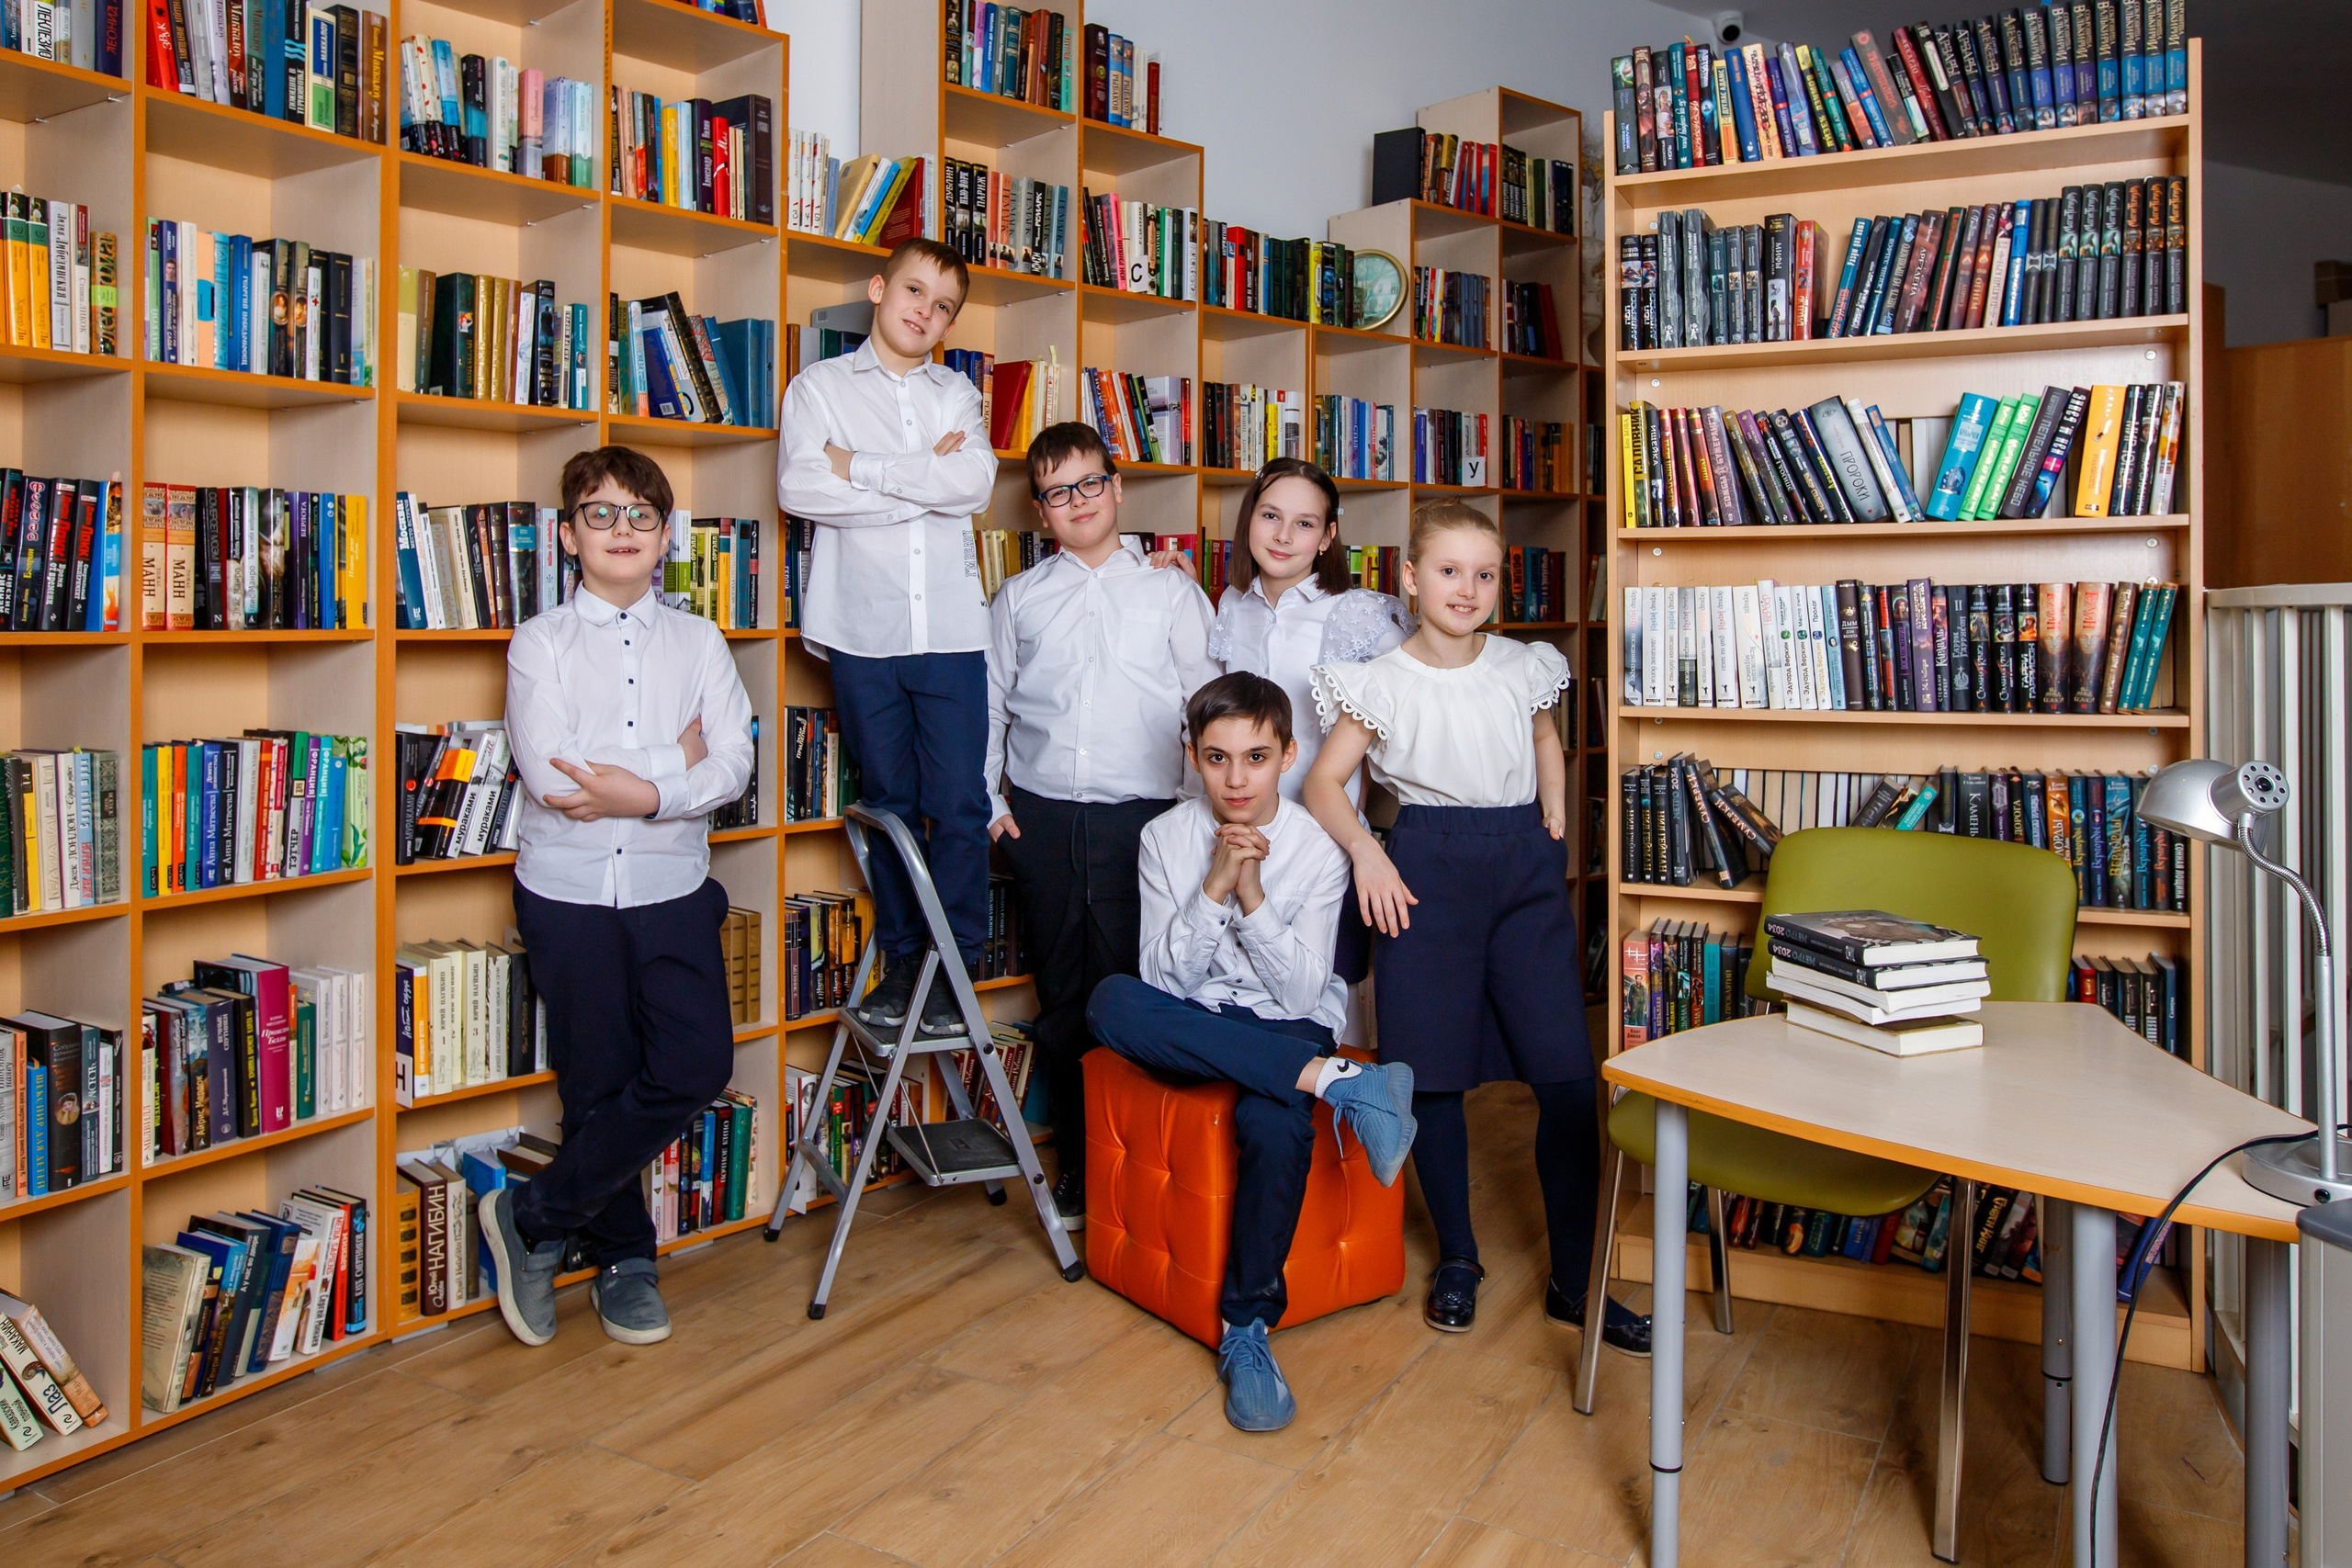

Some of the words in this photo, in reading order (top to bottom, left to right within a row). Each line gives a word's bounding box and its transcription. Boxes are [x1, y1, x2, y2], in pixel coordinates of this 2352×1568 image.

[37, 4, 53, 60] ЛЕКЛЕЗИО
[230, 2, 243, 59] Маккалоу
[2027, 12, 2042, 65] ВАЛЬКИРИИ
[2052, 7, 2066, 61] ВАЛЬКИРИИ
[2075, 5, 2088, 58] ВАЛЬКИРИИ
[1901, 39, 1918, 75] АККАРДО
[1938, 30, 1958, 75] АРВАРЫ
[296, 68, 305, 115] ТЕРНОВНИКЕ
[369, 49, 384, 100] Маккалоу
[1111, 73, 1119, 111] РЫБАКОВ
[1717, 69, 1726, 92] АДАМС
[1122, 79, 1131, 116] РЫБАКОВ
[1719, 92, 1730, 115] ДУГЛАС
[945, 166, 955, 203] ДУБЛИН
[976, 176, 986, 208] ПАРИЖ
[1034, 192, 1043, 227] РЕМАРК
[55, 237, 69, 299] Либединская
[1774, 242, 1782, 270] МИФЫ
[241, 275, 249, 308] ГЕОРГИЙ
[1887, 289, 1901, 310] МЕСТЬ
[1894, 243, 1910, 276] ПРОШЛОГО
[79, 302, 87, 333] ЛИКОК
[1630, 288, 1638, 342] АНДЕРСОН
[1648, 289, 1657, 342] АНДЕРСОН
[239, 310, 249, 366] ПОБЕДОНОСЕЦ
[1650, 424, 1660, 467] ИЩЕЙКА
[1707, 412, 1724, 465] БУМЕРАНГИ
[2021, 419, 2051, 478] ПЕПЕЛЬНОЕ
[1720, 475, 1732, 508] БОМБЫ
[1839, 450, 1871, 502] ПРОРОКИ
[2009, 479, 2030, 507] НЕБО
[51, 517, 72, 558] ЛОКК
[300, 501, 308, 537] БЕРЛОГА
[396, 499, 410, 550] Москва:
[79, 525, 93, 557] ЛОКК
[689, 534, 697, 561] ОРУЭЛЛ
[55, 562, 65, 588] Время
[143, 557, 155, 597] МАНН
[173, 559, 185, 599] МАНН
[232, 568, 243, 594] Манро
[247, 565, 256, 592] Манро
[1782, 642, 1792, 666] Веркин
[1799, 641, 1808, 666] Веркин
[1952, 632, 1961, 659] ГАРРИ
[1957, 615, 1967, 657] ГАРРИСОН
[1784, 667, 1794, 695] Эдуард
[1801, 667, 1810, 695] Эдуард
[2028, 643, 2037, 699] ГАРРИСОН
[1669, 767, 1679, 790] 2034
[223, 794, 233, 838] Матвеева
[405, 794, 415, 840] МУРАКАМИ
[476, 790, 497, 842] мураками
[1672, 790, 1680, 819] МЕТРО
[1687, 773, 1711, 824] СУМЕРКИ
[1968, 792, 1982, 837] КАМЕНЬ
[2012, 799, 2023, 835] ДОРОГА
[208, 795, 218, 840] Матвеева
[456, 793, 478, 844] мураками
[1642, 808, 1652, 830] НИЛ
[1657, 810, 1667, 831] НИЛ
[1713, 798, 1757, 840] СУМЕРКИ
[67, 813, 77, 861] ЛОНДОН
[208, 840, 217, 866] Анна
[222, 839, 232, 864] Анна
[288, 829, 299, 870] ТЭТЧЕР
[1643, 831, 1654, 872] ГЕЙМАН
[1657, 832, 1668, 874] ГЕЙМАН
[2174, 842, 2184, 869] СОННАЯ
[69, 864, 79, 891] Джек
[2174, 869, 2185, 900] ЛОЩИНА
[471, 963, 480, 998] НАГИБИН
[471, 999, 480, 1021] ЮРИЙ
[35, 1073, 45, 1127] ШЕКСПИР
[194, 1076, 206, 1106] Мердок
[142, 1105, 152, 1153] МЕЛВИЛЛ
[195, 1107, 207, 1136] Айрис
[721, 1120, 729, 1145] КИНО
[718, 1148, 728, 1183] НОЧНОЕ
[334, 1216, 345, 1239] MEDIA
[427, 1185, 445, 1270] НАГИБИН
[325, 1239, 340, 1276] SAPIENS
[316, 1293, 329, 1320] Сергей
[2, 1317, 29, 1353] МАКАНИН
[42, 1383, 65, 1416] Лаз
